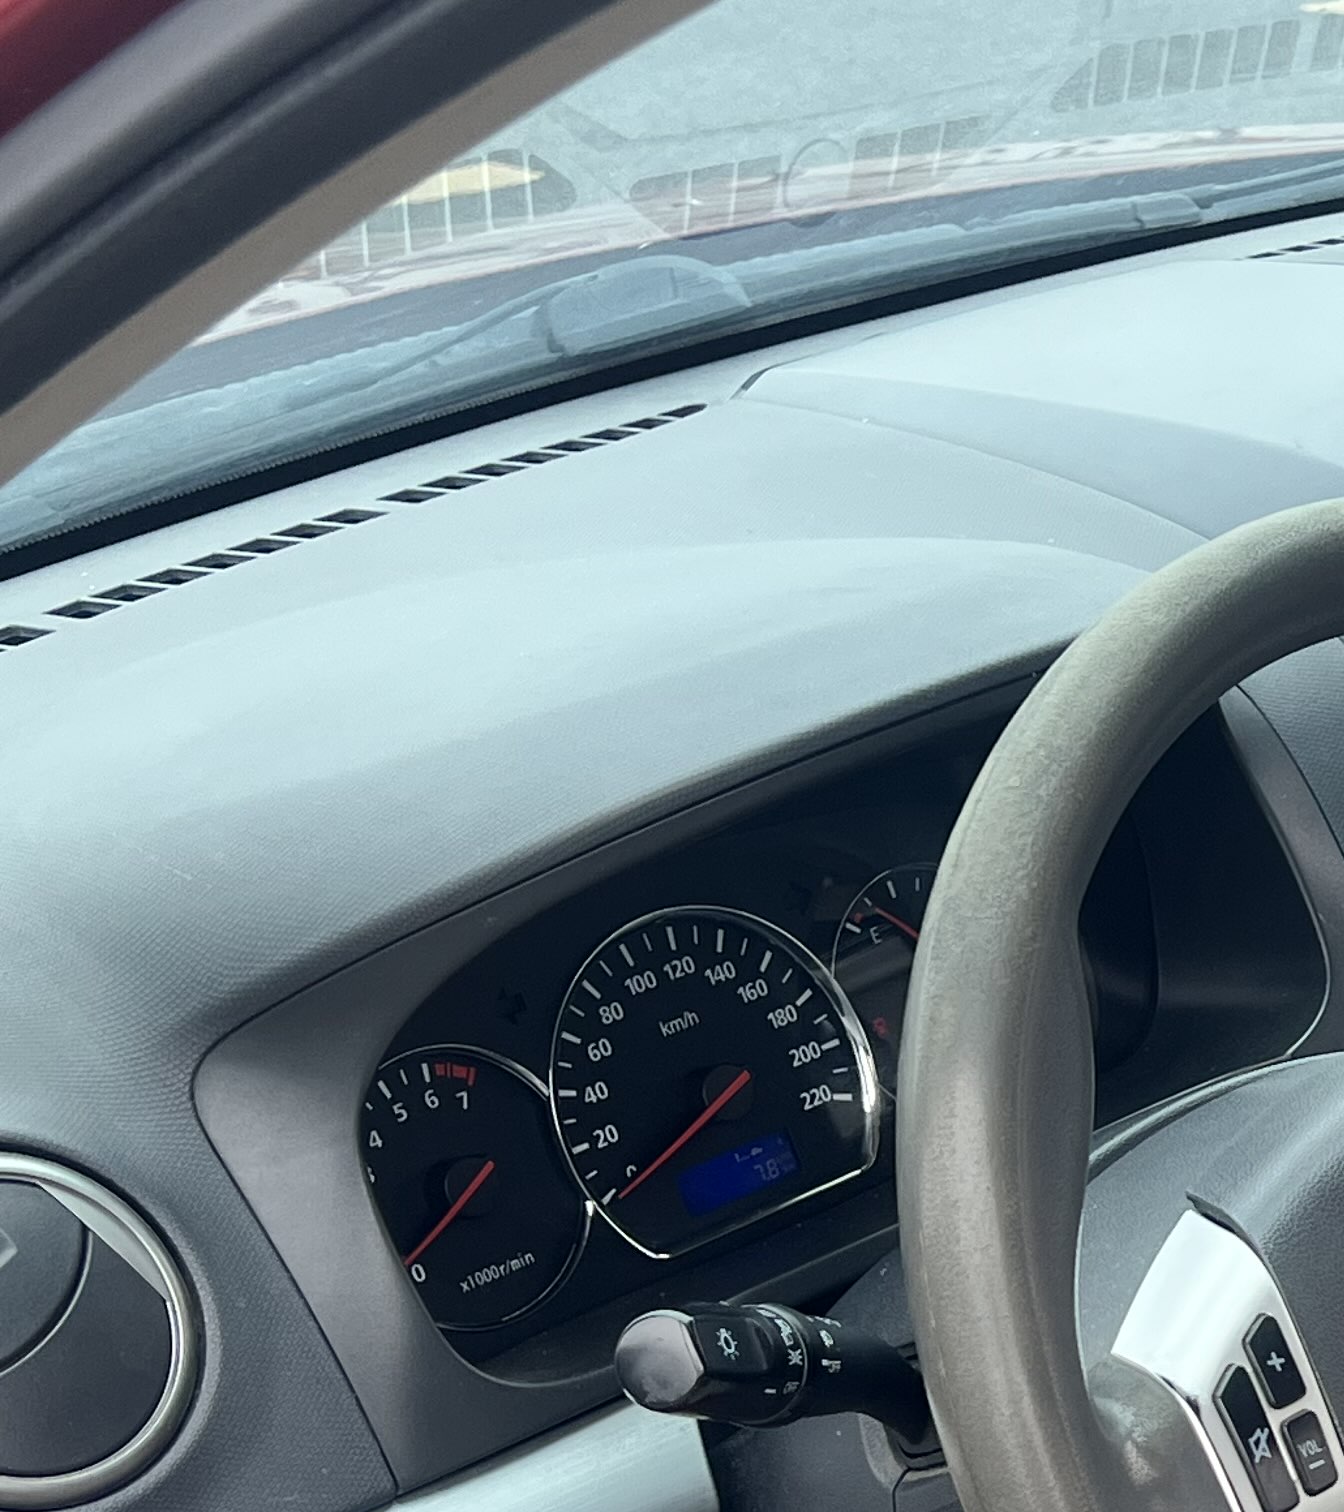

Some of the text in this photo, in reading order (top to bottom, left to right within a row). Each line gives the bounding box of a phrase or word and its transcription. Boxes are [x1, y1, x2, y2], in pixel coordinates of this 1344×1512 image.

[869, 926, 882, 944] E
[663, 955, 696, 981] 120
[704, 961, 736, 986] 140
[624, 970, 657, 996] 100
[737, 978, 768, 1003] 160
[599, 1001, 624, 1025] 80
[658, 1010, 700, 1037] km/h
[767, 1003, 798, 1029] 180
[587, 1037, 612, 1062] 60
[788, 1040, 821, 1067] 200
[424, 1089, 440, 1109] 6
[455, 1091, 469, 1110] 7
[584, 1081, 609, 1104] 40
[800, 1084, 832, 1110] 220
[392, 1102, 408, 1122] 5
[368, 1130, 383, 1148] 4
[592, 1124, 619, 1149] 20
[411, 1263, 426, 1283] 0
[459, 1251, 536, 1294] x1000r/min
[1296, 1439, 1323, 1458] VOL
